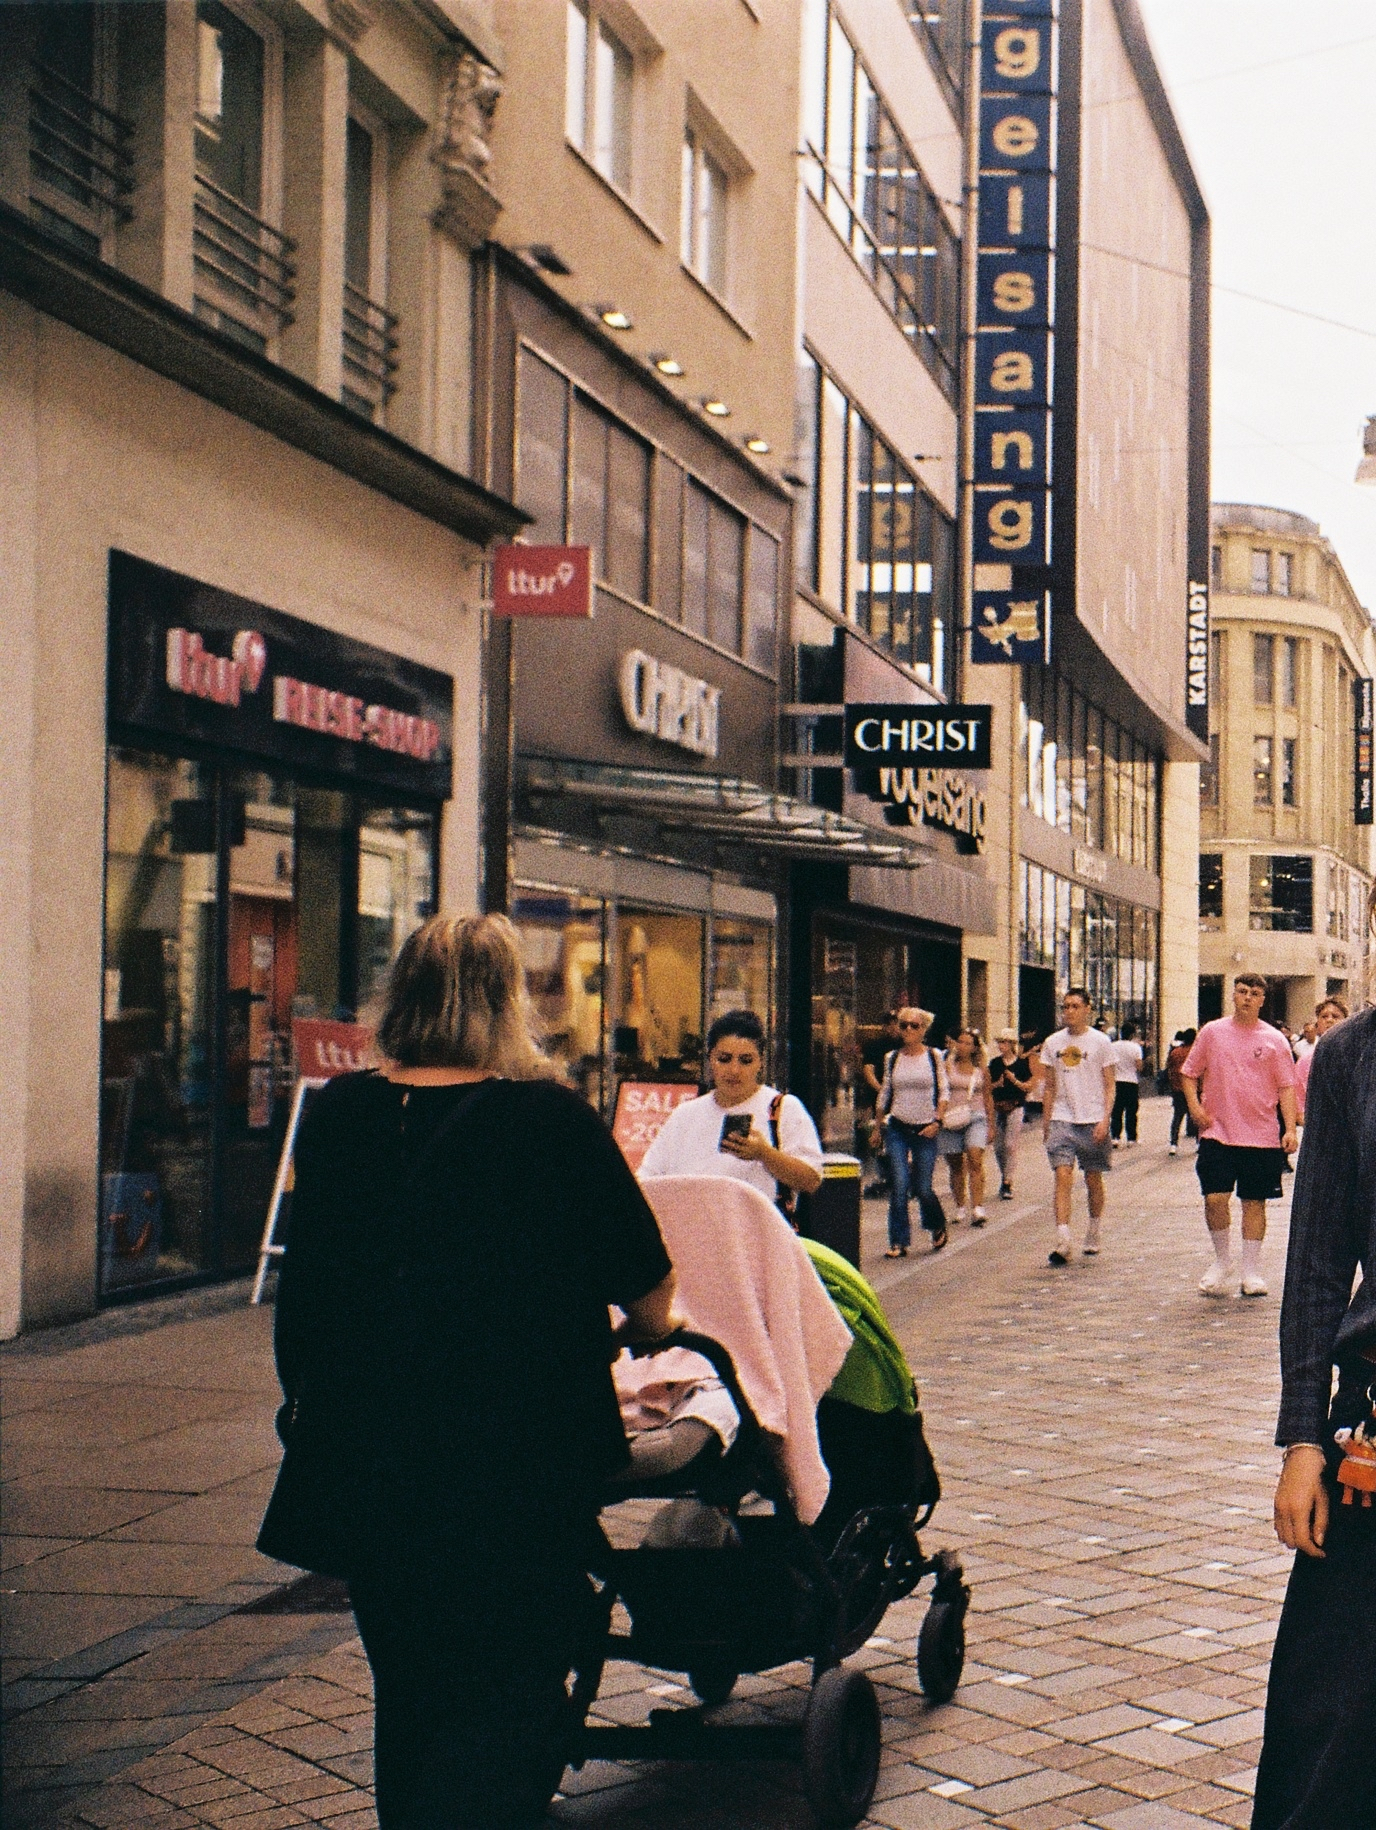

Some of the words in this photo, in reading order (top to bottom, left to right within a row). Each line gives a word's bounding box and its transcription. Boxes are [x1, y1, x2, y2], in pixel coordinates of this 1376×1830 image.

[988, 0, 1041, 550] gelsang
[1188, 580, 1208, 706] KARSTADT
[619, 647, 722, 760] CHRIST
[853, 718, 982, 752] CHRIST
[1361, 779, 1370, 810] Thalia
